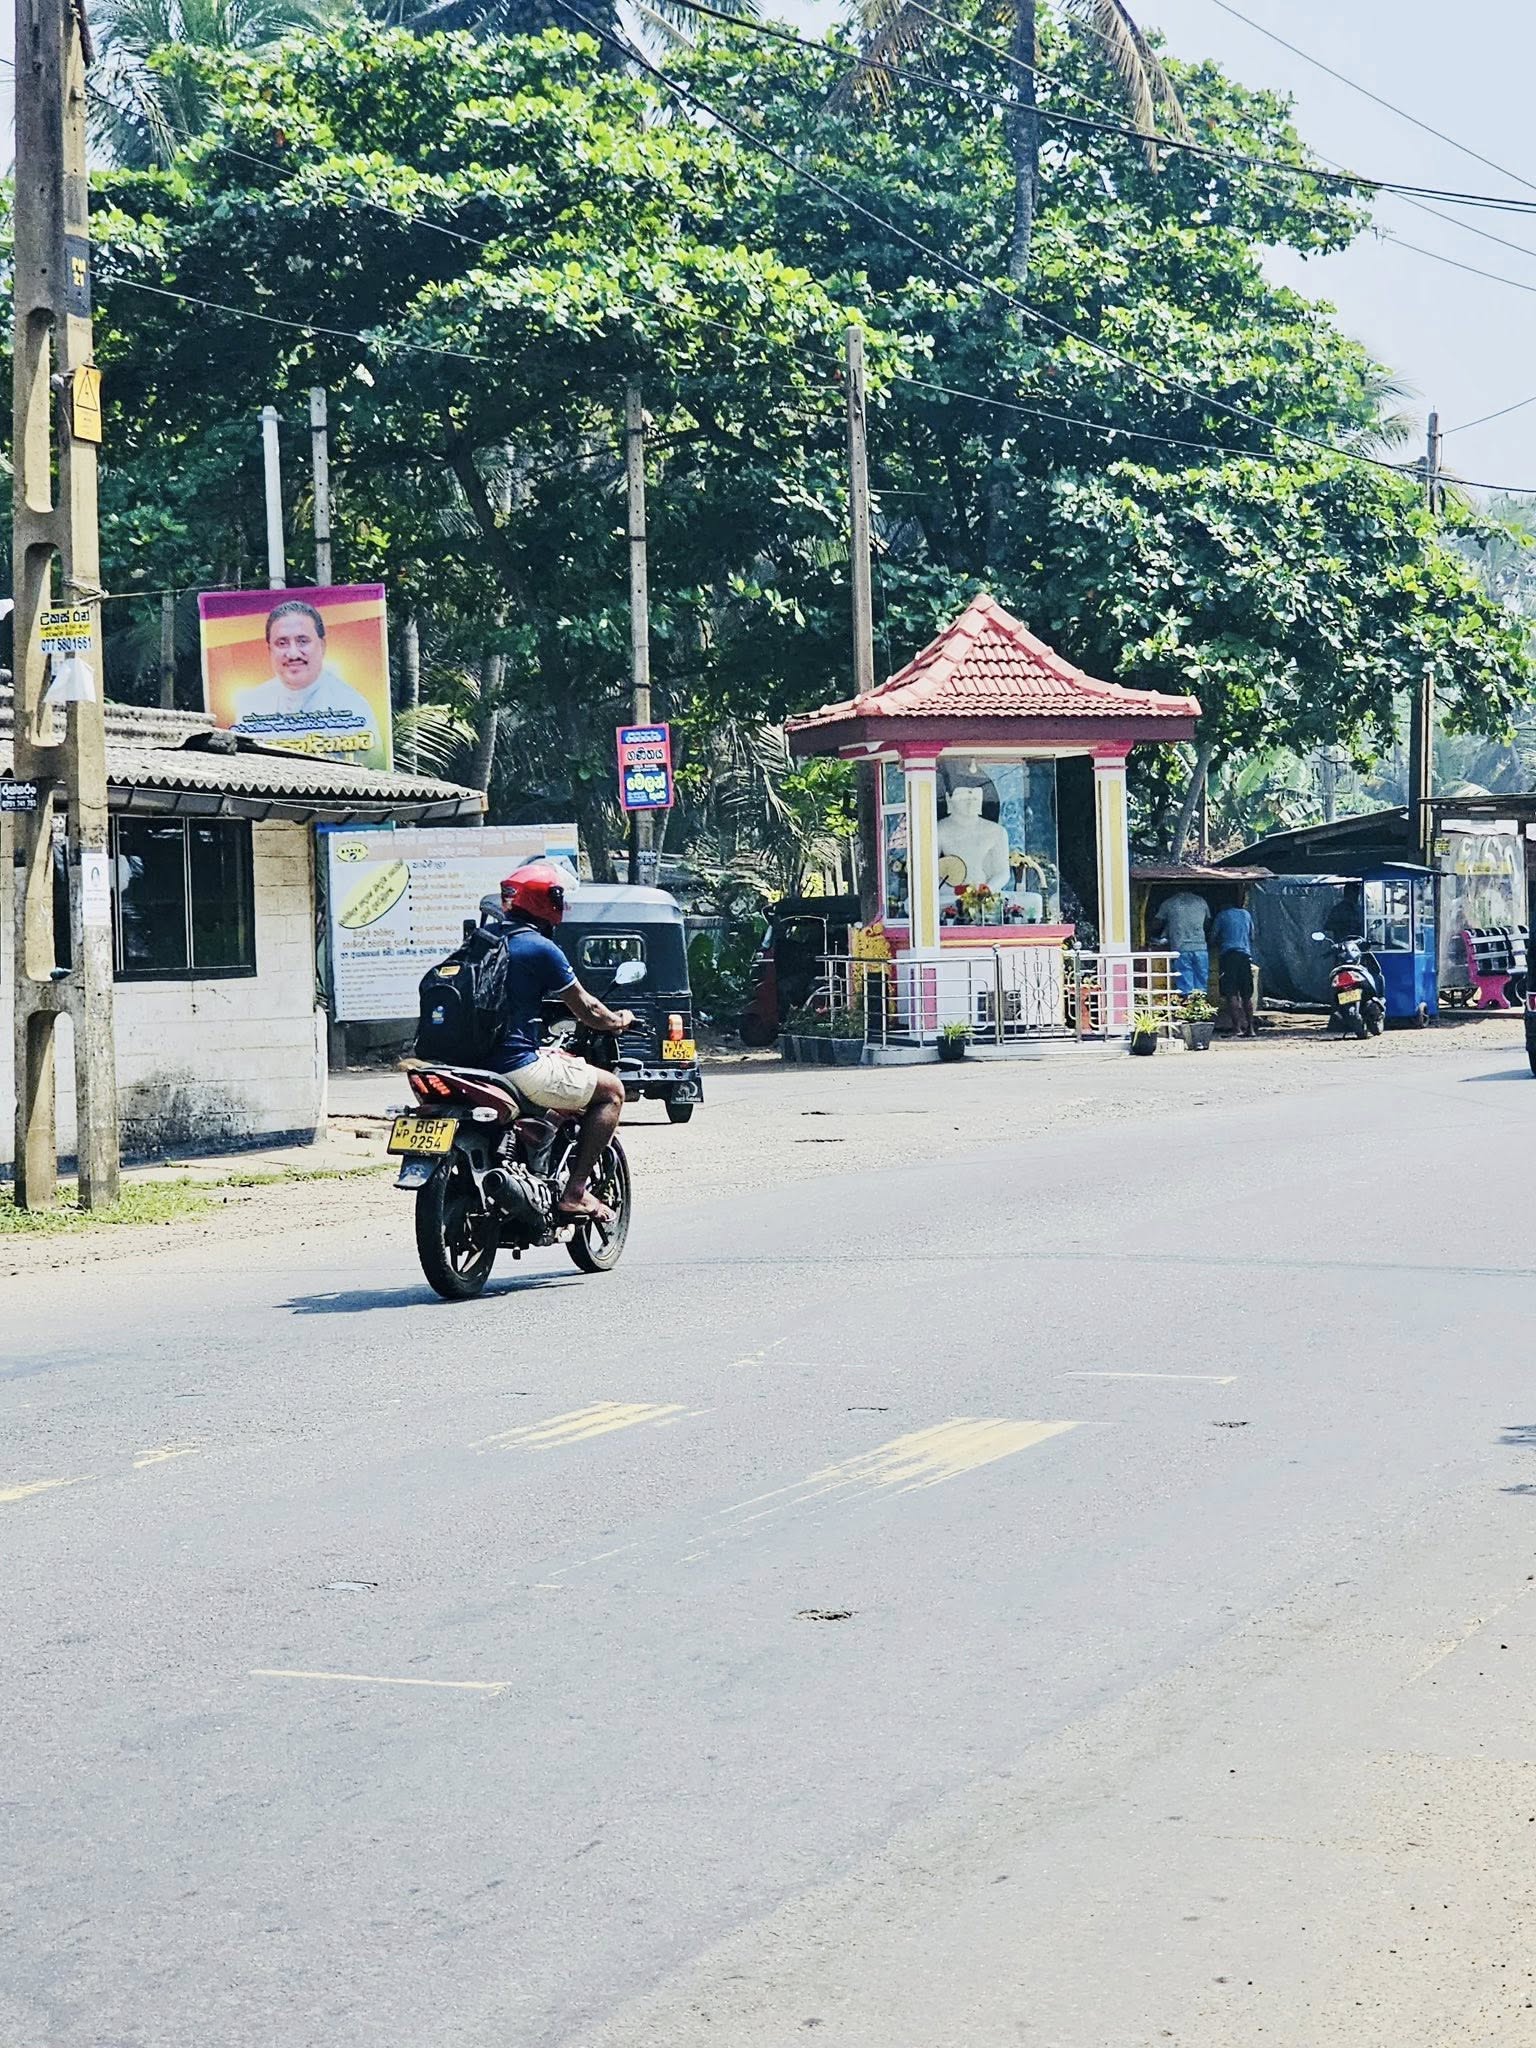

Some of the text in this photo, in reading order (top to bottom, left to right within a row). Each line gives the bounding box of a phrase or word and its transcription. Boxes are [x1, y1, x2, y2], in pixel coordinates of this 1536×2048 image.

[73, 610, 90, 622] රන්
[627, 747, 664, 761] ගණිතය
[395, 1128, 410, 1139] WP
[415, 1120, 446, 1135] BGH
[409, 1135, 441, 1149] 9254
